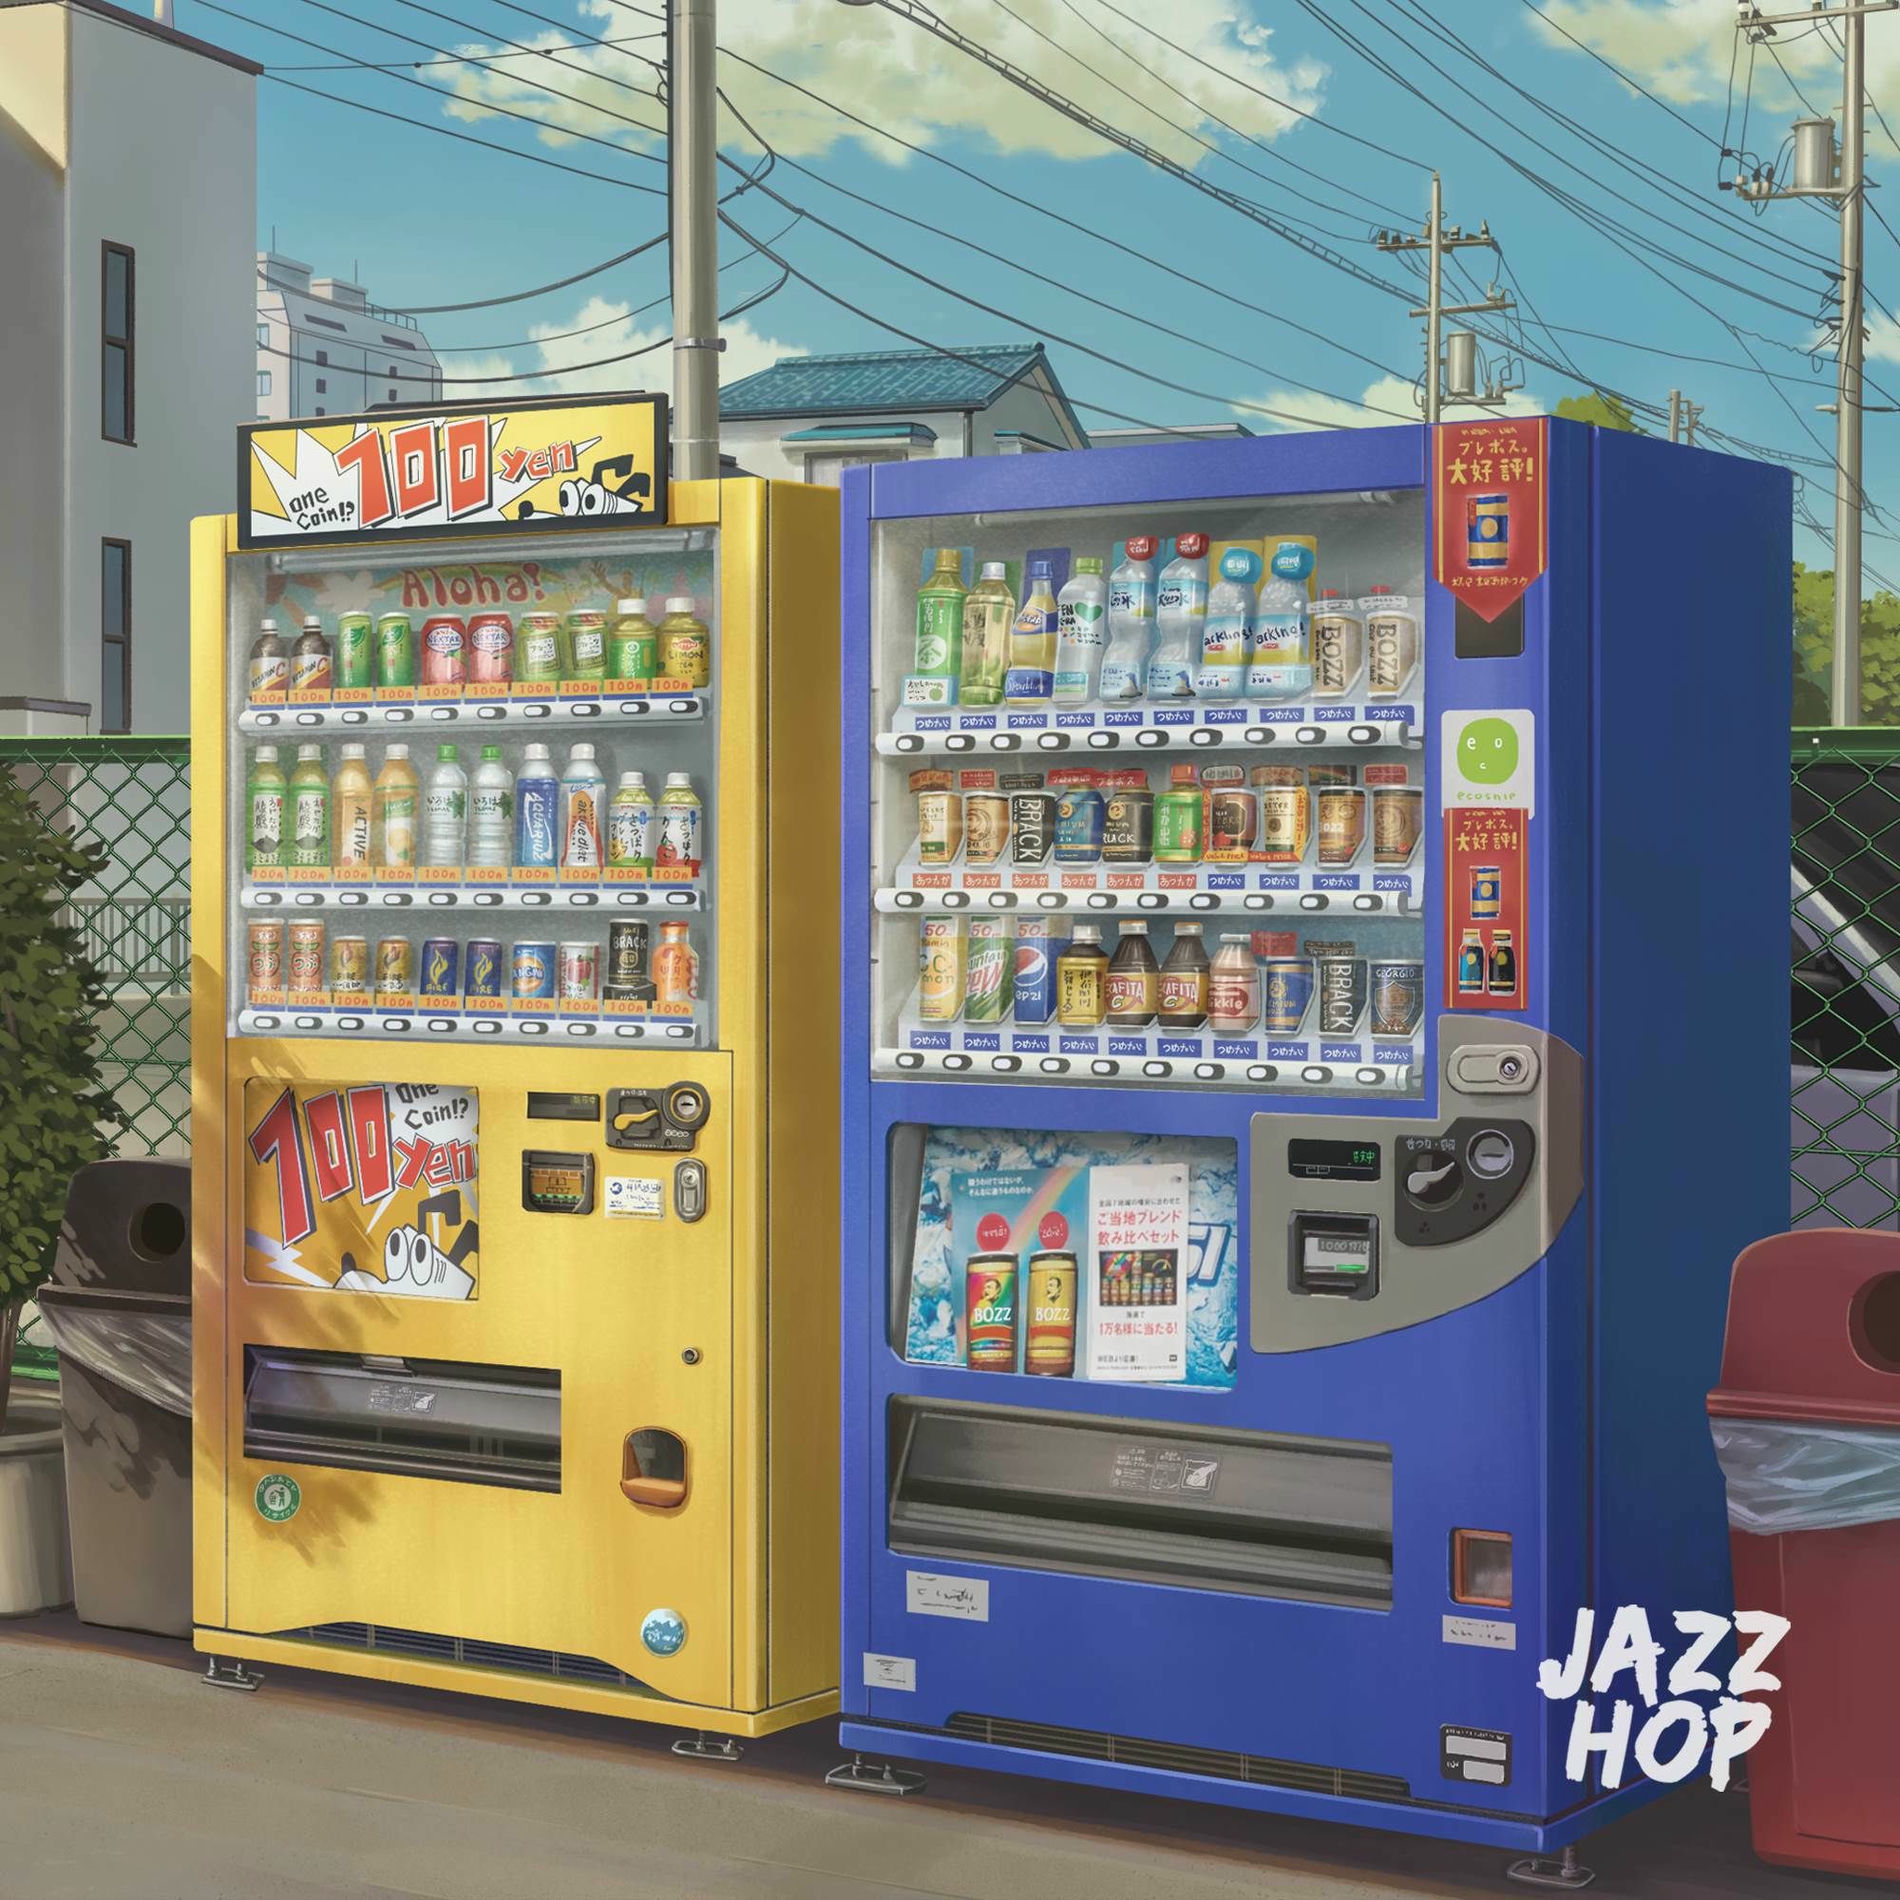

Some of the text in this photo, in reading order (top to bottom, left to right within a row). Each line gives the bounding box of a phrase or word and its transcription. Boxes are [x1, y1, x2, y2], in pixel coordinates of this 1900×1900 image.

[288, 485, 328, 512] one
[334, 415, 579, 528] 100 yen
[401, 562, 547, 609] Aloha!
[1321, 625, 1344, 686] BOZZ
[1376, 623, 1399, 686] BOZZ
[354, 806, 368, 860] ACTIVE
[1019, 798, 1042, 860] BRACK
[1327, 963, 1354, 1032] BRACK
[405, 1097, 470, 1130] Coin!?
[248, 1085, 396, 1250] 100
[393, 1133, 475, 1189] yen
[1098, 1209, 1183, 1226] ご当地ブレンド
[1098, 1228, 1180, 1246] 飲み比べセット
[973, 1307, 1012, 1323] BOZZ
[1034, 1306, 1071, 1322] BOZZ
